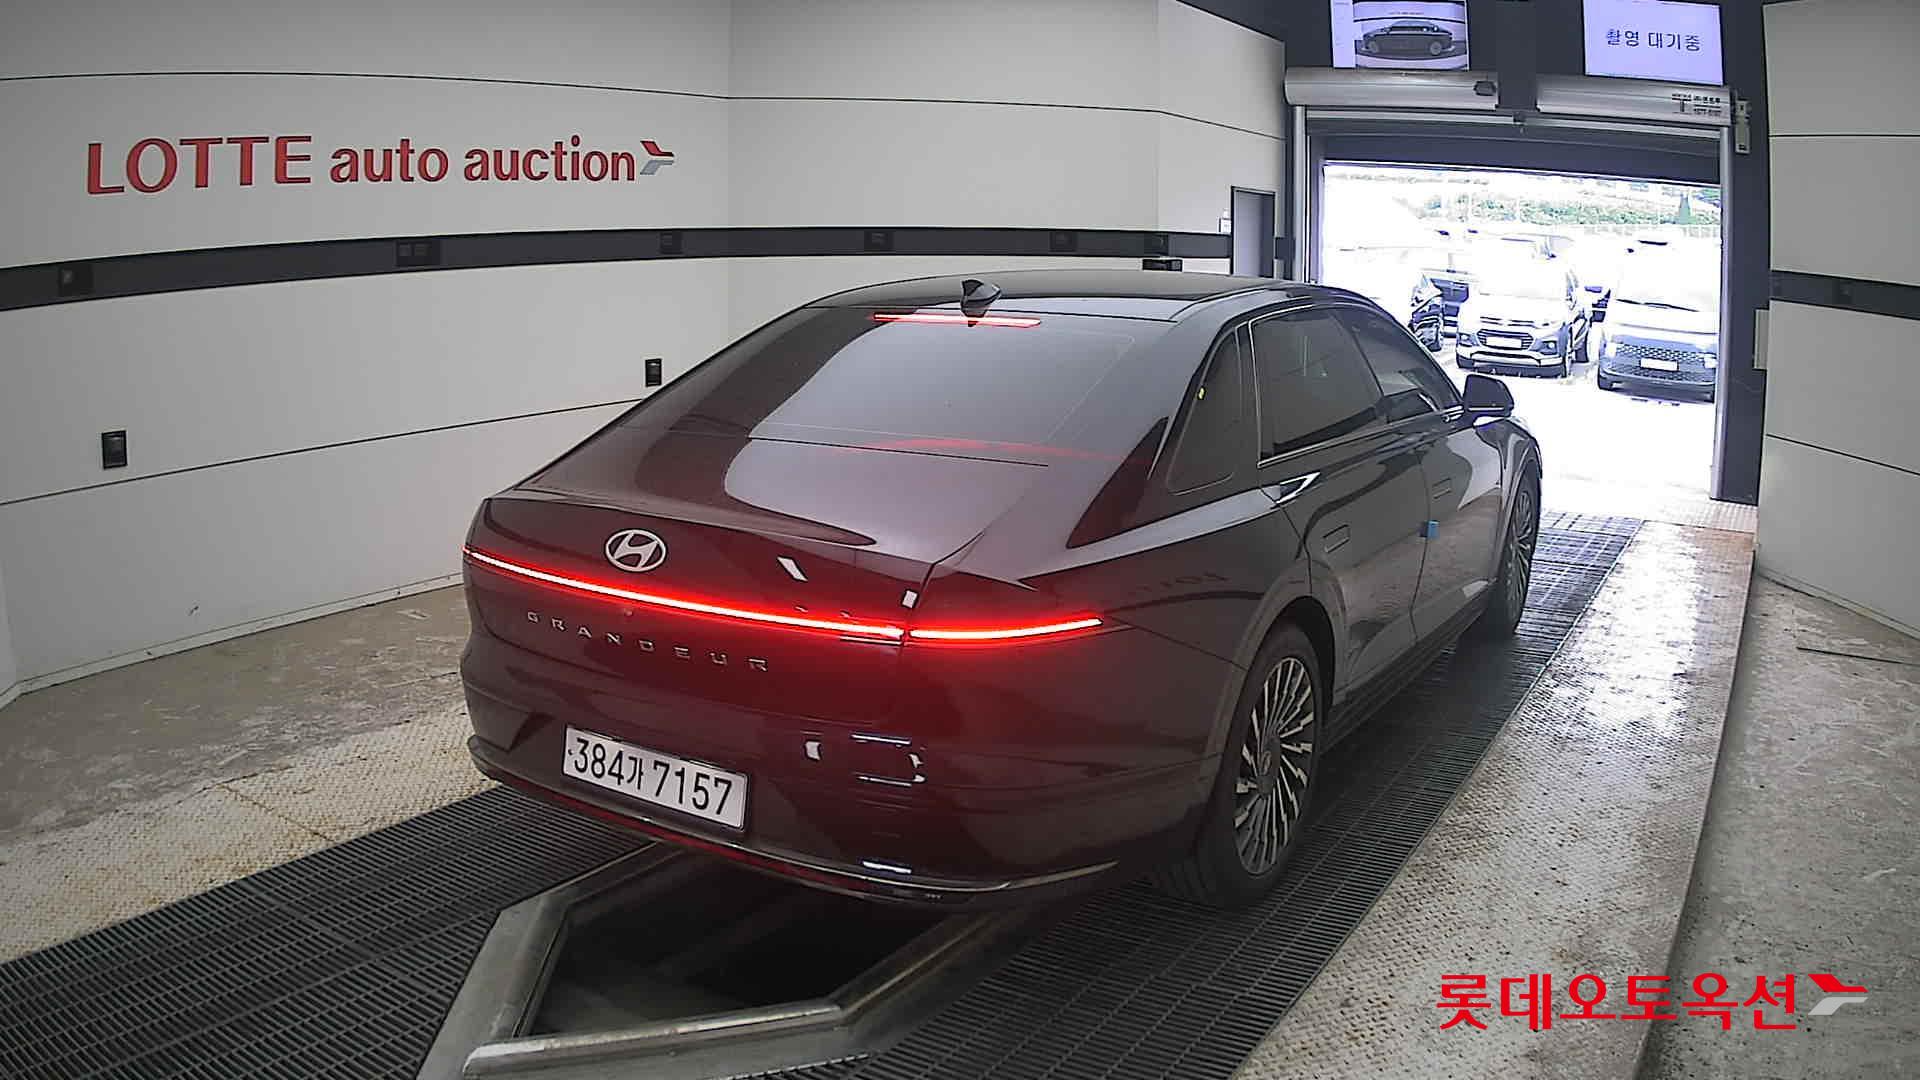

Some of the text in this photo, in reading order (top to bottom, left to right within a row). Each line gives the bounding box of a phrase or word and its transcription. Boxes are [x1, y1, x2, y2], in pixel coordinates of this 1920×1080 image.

[1607, 29, 1700, 52] 촬영 대기중
[86, 134, 636, 195] LOTTE auto auction
[527, 611, 768, 671] GRANDEUR
[573, 737, 733, 816] 384가 7157
